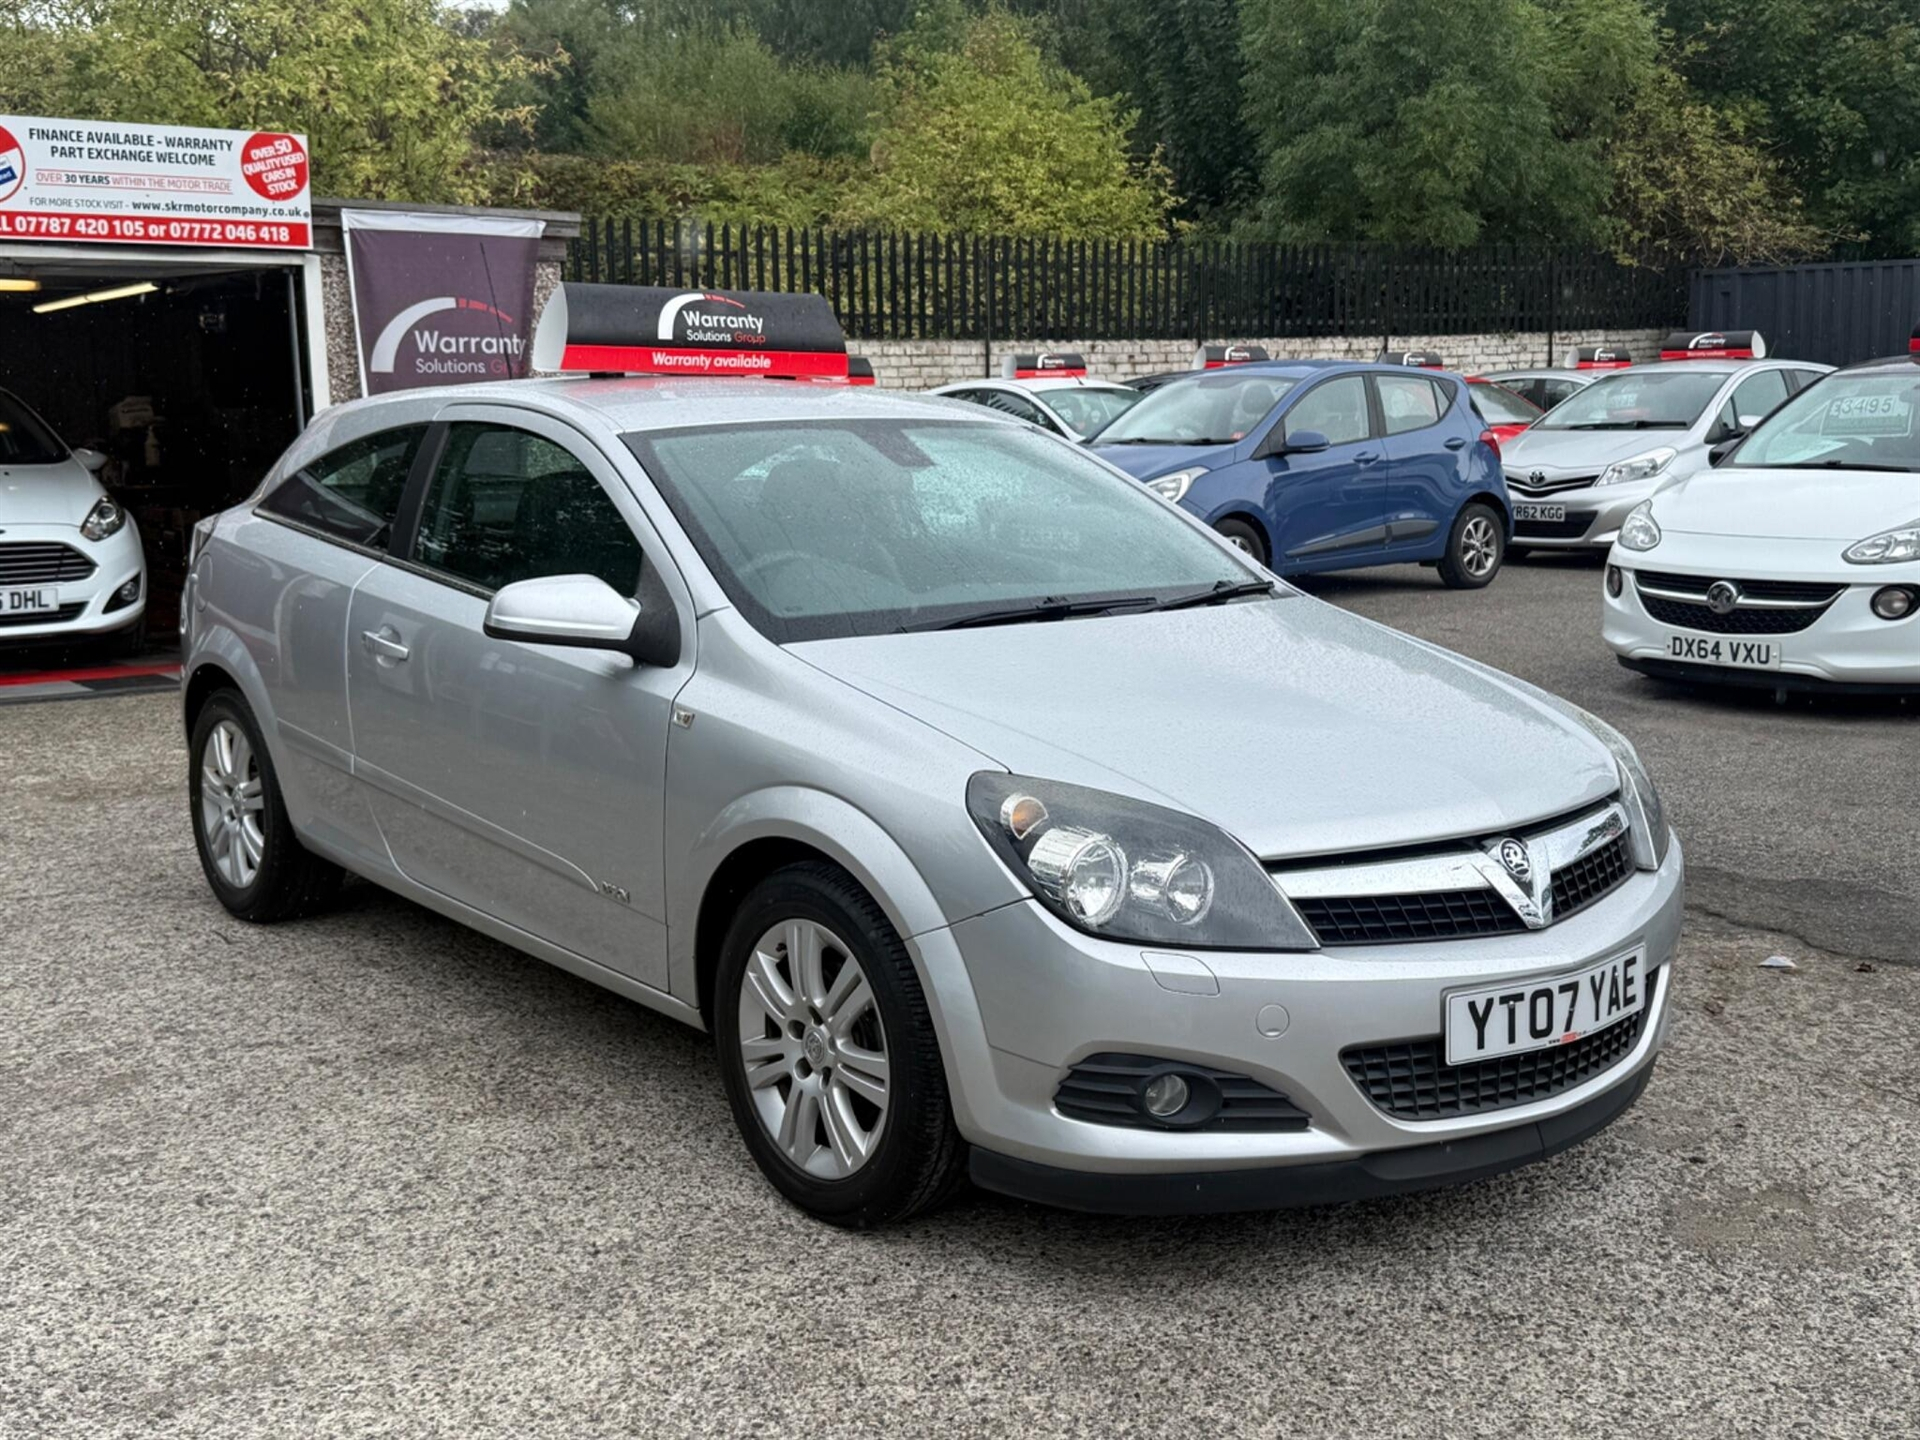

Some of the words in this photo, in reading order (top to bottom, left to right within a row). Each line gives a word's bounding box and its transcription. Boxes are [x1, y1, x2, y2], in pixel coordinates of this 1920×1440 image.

[29, 128, 84, 143] FINANCE
[87, 131, 155, 147] AVAILABLE
[164, 135, 233, 151] WARRANTY
[250, 145, 276, 160] OVER
[274, 138, 292, 154] 50
[51, 146, 84, 159] PART
[87, 148, 154, 163] EXCHANGE
[156, 151, 216, 166] WELCOME
[243, 155, 282, 176] QUALITY
[282, 152, 305, 166] USED
[36, 172, 62, 182] OVER
[64, 173, 77, 184] 30
[79, 174, 110, 185] YEARS
[111, 176, 146, 187] WITHIN
[148, 178, 166, 188] THE
[167, 179, 200, 190] MOTOR
[202, 180, 232, 192] TRADE
[262, 168, 286, 183] CARS
[285, 167, 297, 178] IN
[267, 179, 298, 195] STOCK
[30, 197, 47, 206] FOR
[48, 198, 72, 207] MORE
[75, 199, 102, 208] STOCK
[103, 200, 123, 209] VISIT
[132, 200, 302, 217] www.skrmotorcompany.co.uk
[14, 216, 71, 234] 07787
[75, 218, 109, 235] 420
[112, 220, 145, 237] 105
[148, 224, 167, 238] or
[169, 222, 222, 239] 07772
[225, 224, 256, 240] 046
[259, 226, 290, 242] 418
[682, 310, 763, 333] Warranty
[414, 330, 526, 361] Warranty
[687, 330, 731, 342] Solutions
[734, 331, 766, 345] Group
[416, 358, 486, 374] Solutions
[652, 351, 712, 370] Warranty
[713, 354, 771, 368] available
[1540, 506, 1563, 519] KGG
[9, 590, 50, 610] DHL
[1671, 636, 1722, 660] DX64
[1729, 641, 1770, 664] VXU
[1468, 980, 1579, 1050] YT07
[1590, 956, 1637, 1022] YAE
